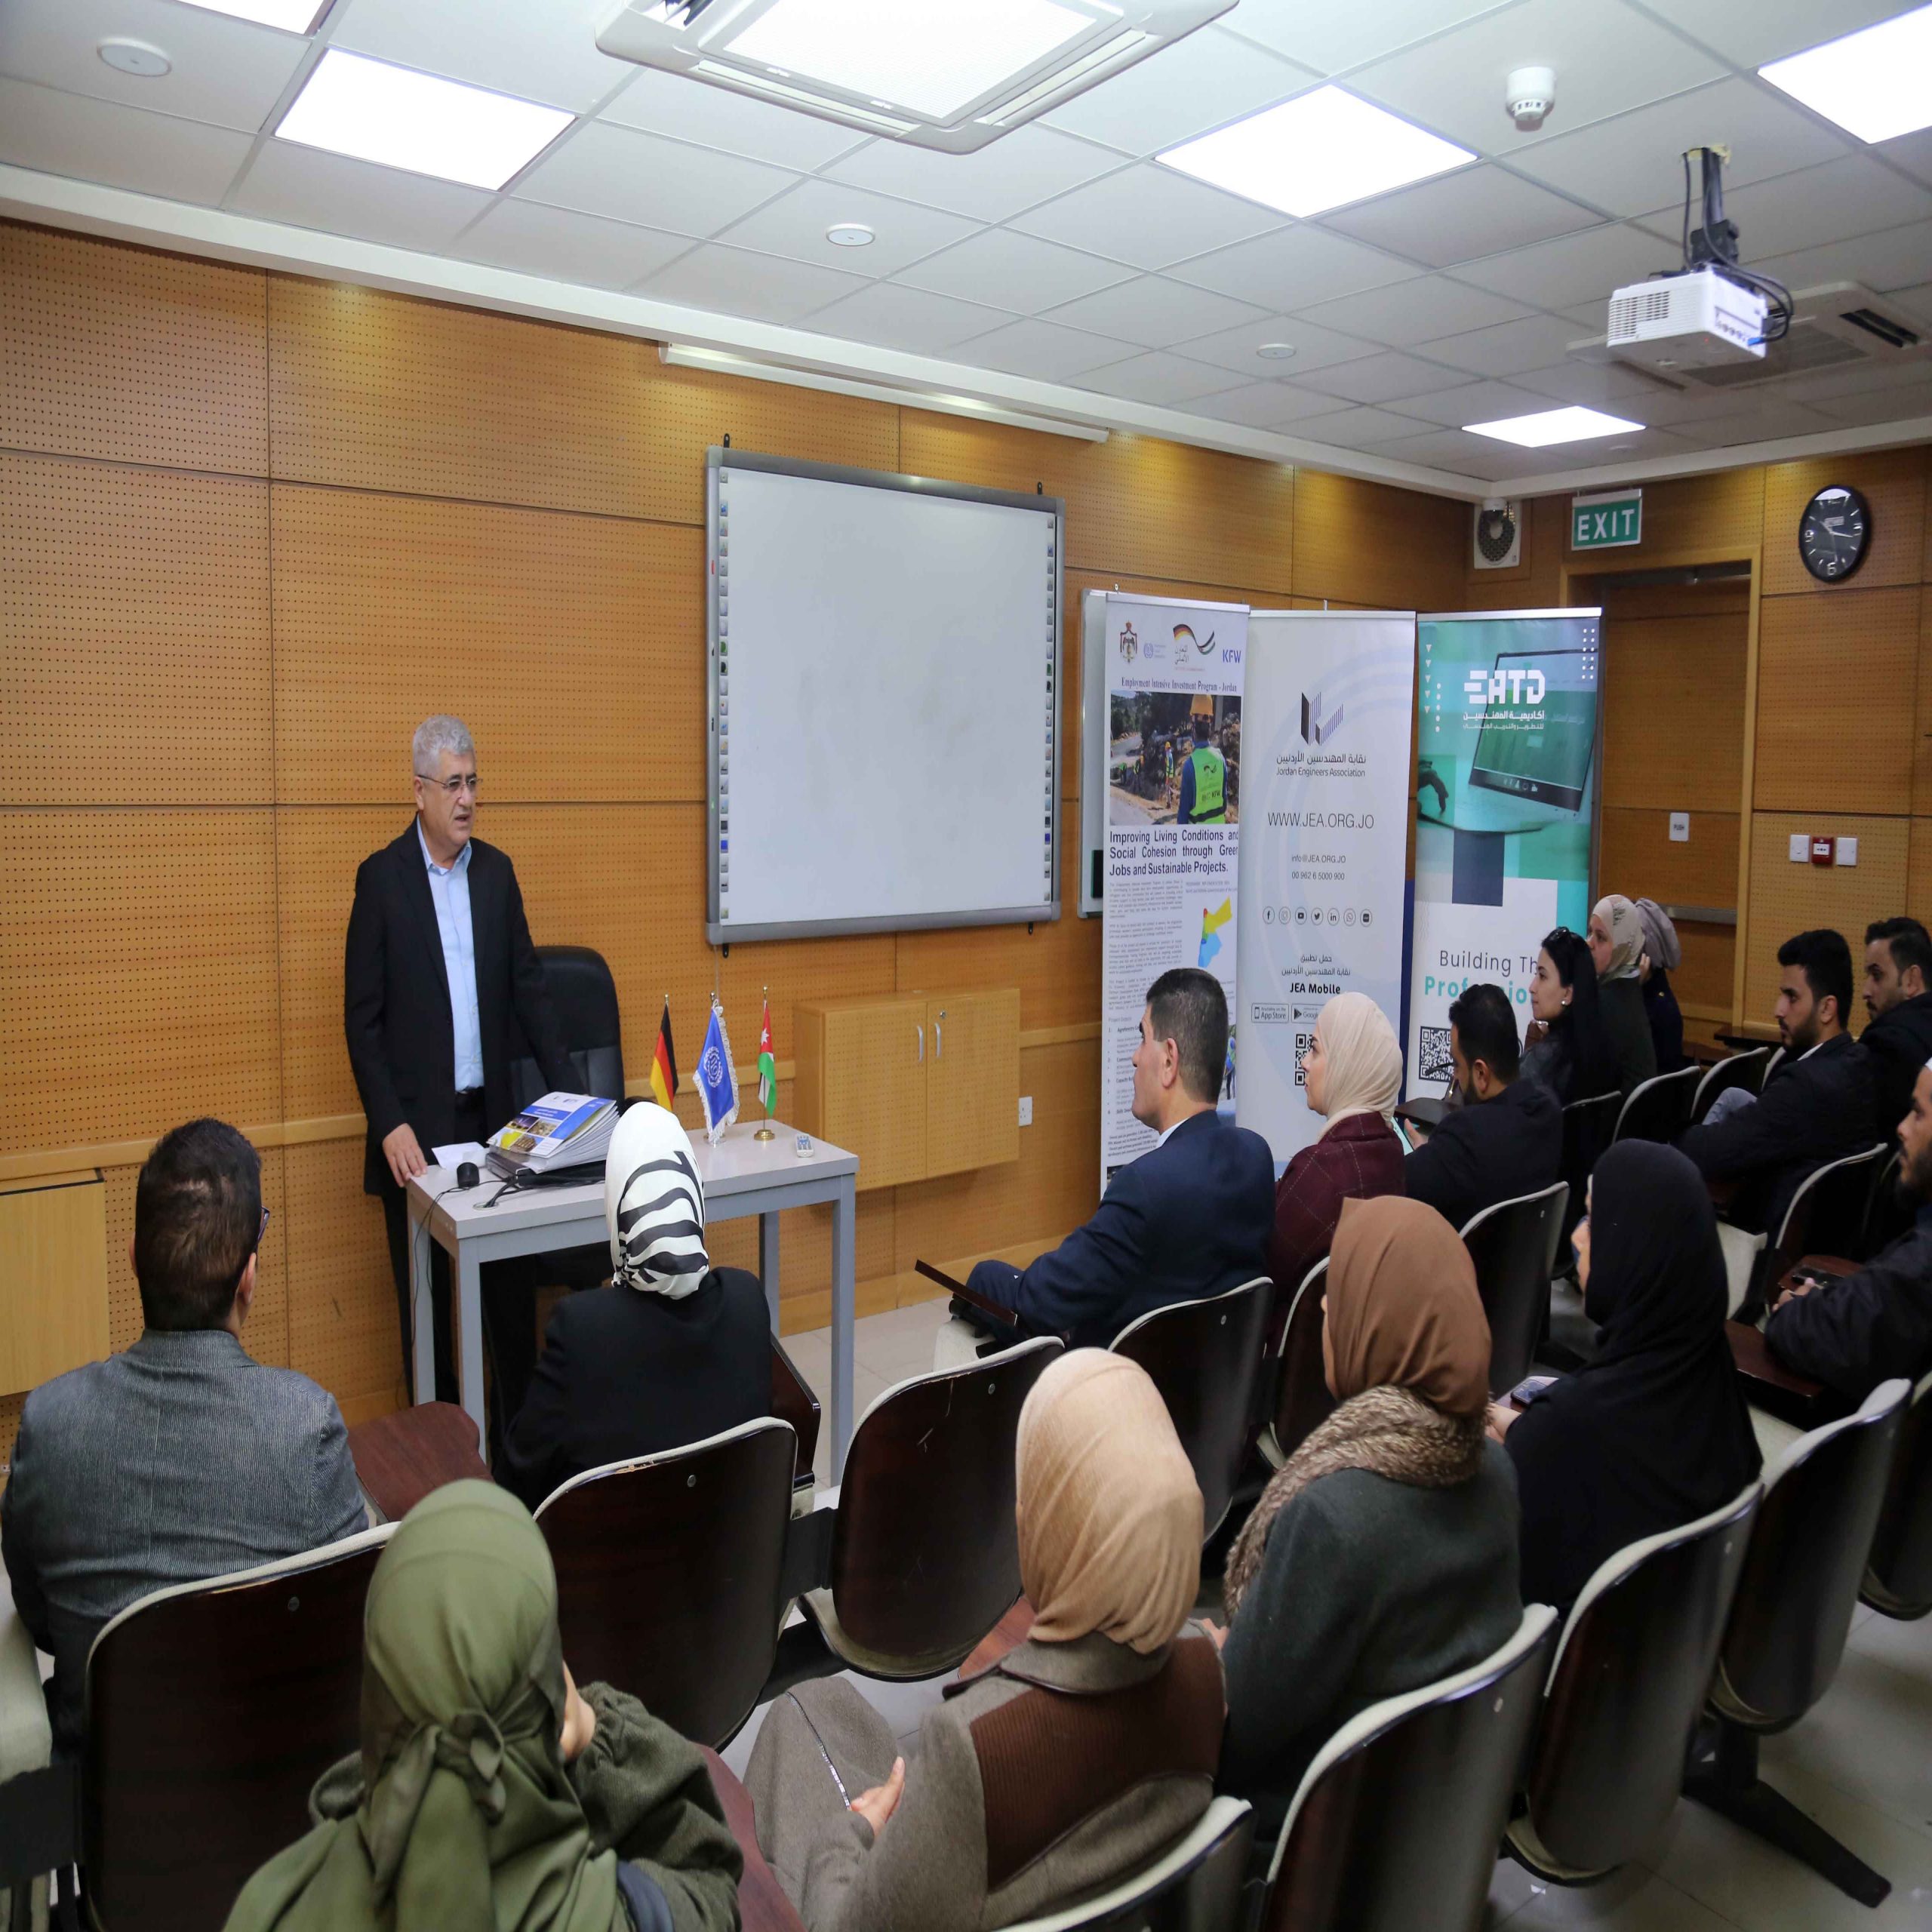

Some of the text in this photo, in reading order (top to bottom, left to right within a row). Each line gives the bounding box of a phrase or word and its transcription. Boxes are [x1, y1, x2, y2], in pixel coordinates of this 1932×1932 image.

[1577, 509, 1635, 541] EXIT
[1121, 677, 1150, 689] Employment
[1152, 678, 1171, 688] Intensive
[1172, 679, 1196, 690] Investment
[1198, 680, 1218, 692] Program
[1222, 682, 1237, 692] Jordan
[1464, 669, 1546, 704] EATD
[1463, 710, 1508, 721] المهندسين
[1307, 753, 1346, 764] المهندسين
[1348, 754, 1366, 765] نقابة
[1276, 767, 1366, 777] Jordan Engineers Association
[1268, 812, 1374, 829] WWW.JEA.ORG.JO
[1109, 831, 1150, 845] Improving
[1154, 830, 1177, 844] Living
[1182, 829, 1223, 841] Conditions
[1109, 846, 1136, 859] Social
[1142, 846, 1177, 858] Cohesion
[1183, 844, 1213, 859] through
[1109, 861, 1229, 876] Jobs and Sustainable Projects.
[1291, 871, 1345, 881] 00 962 6 5000 900
[1300, 954, 1332, 964] حمل تطبيق
[1440, 949, 1538, 978] Building Th
[1305, 967, 1335, 977] المهندسين
[1337, 967, 1351, 977] نقابة
[1290, 983, 1340, 994] JEA Mobile
[1261, 1011, 1287, 1020] App Store
